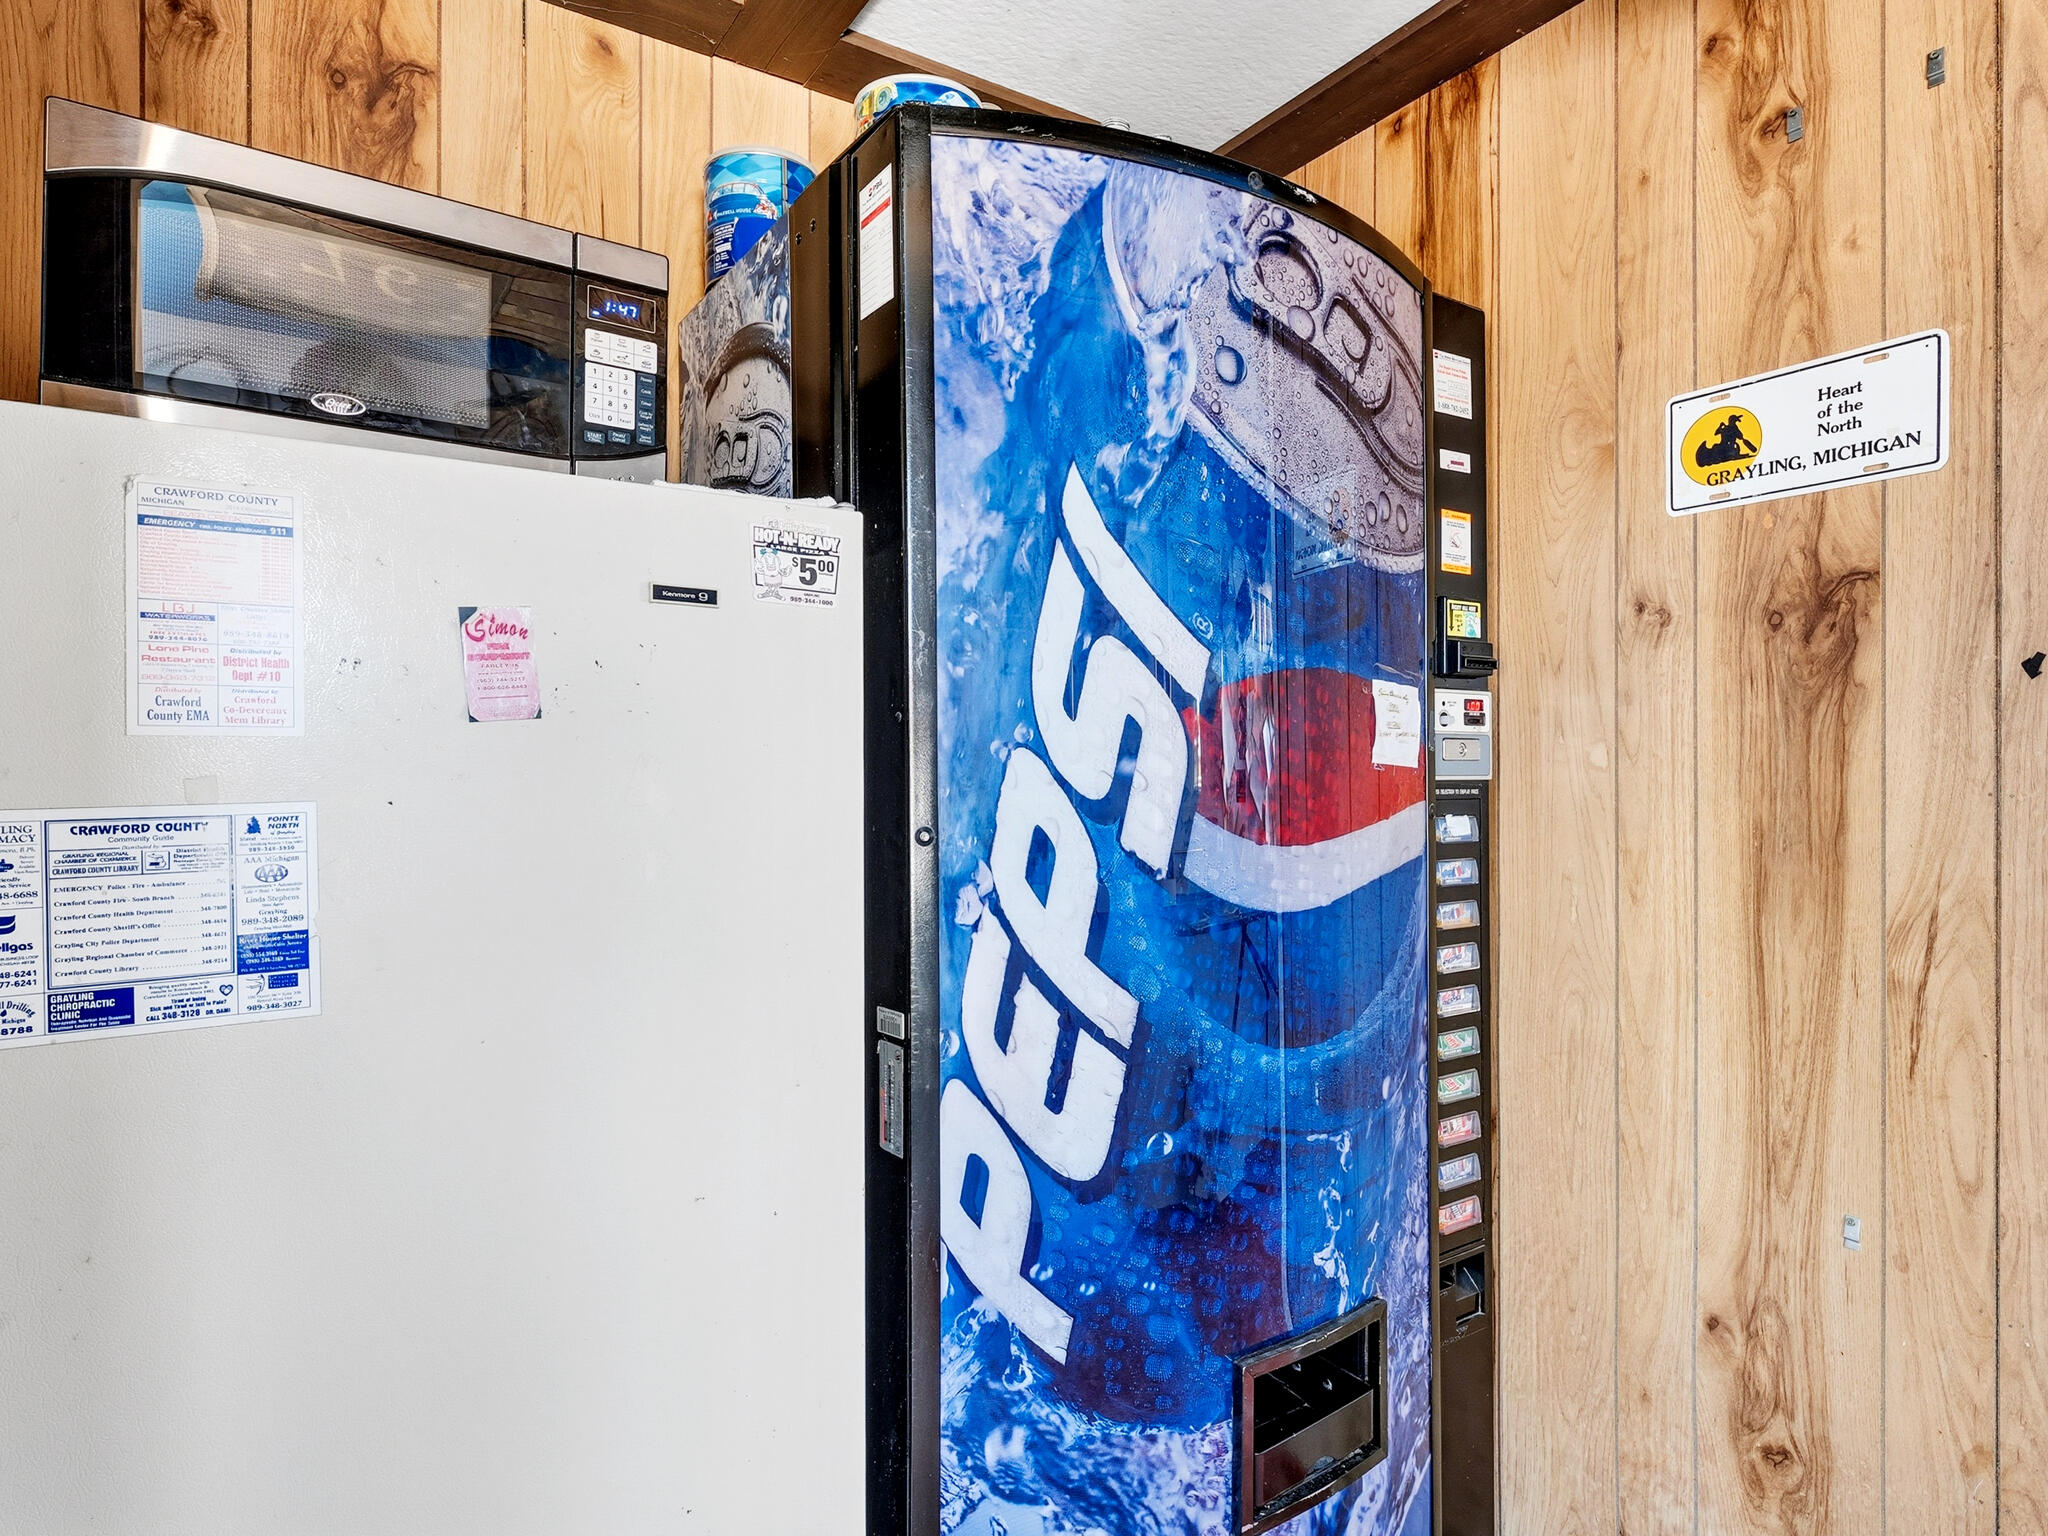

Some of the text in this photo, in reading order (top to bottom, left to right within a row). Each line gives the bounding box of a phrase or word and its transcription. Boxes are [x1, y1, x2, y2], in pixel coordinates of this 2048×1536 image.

[604, 301, 639, 319] 1:47
[1817, 381, 1863, 402] Heart
[1817, 400, 1864, 419] of the
[1817, 416, 1862, 437] North
[1706, 431, 1921, 488] GRAYLING, MICHIGAN
[141, 496, 184, 506] MICHIGAN
[154, 486, 278, 506] CRAWFORD COUNTY
[144, 517, 196, 528] EMERGENCY
[662, 589, 708, 601] Kenmore 9
[465, 613, 529, 642] Simon
[141, 654, 216, 664] Restaurant
[223, 656, 289, 669] District Health
[232, 670, 252, 683] Dept
[155, 695, 201, 707] Crawford
[147, 709, 209, 723] County EMA
[70, 821, 208, 836] CRAWFORD COUNTY
[108, 835, 150, 844] Community
[52, 864, 139, 876] CRAWFORD COUNTY LIBRARY
[54, 885, 104, 893] EMERGENCY
[54, 899, 86, 908] Crawford
[54, 913, 86, 921] Crawford
[940, 459, 1212, 1365] PEPSI
[54, 927, 86, 935] Crawford
[54, 941, 84, 949] Grayling
[86, 940, 99, 948] City
[122, 936, 159, 944] Department
[54, 955, 84, 963] Grayling
[86, 953, 114, 961] Regional
[55, 969, 87, 978] Crawford
[50, 991, 95, 1004] GRAYLING
[50, 998, 116, 1012] CHIROPRACTIC
[50, 1010, 81, 1021] CLINIC
[161, 1008, 201, 1020] 348-3128
[1, 1025, 34, 1036] 8788
